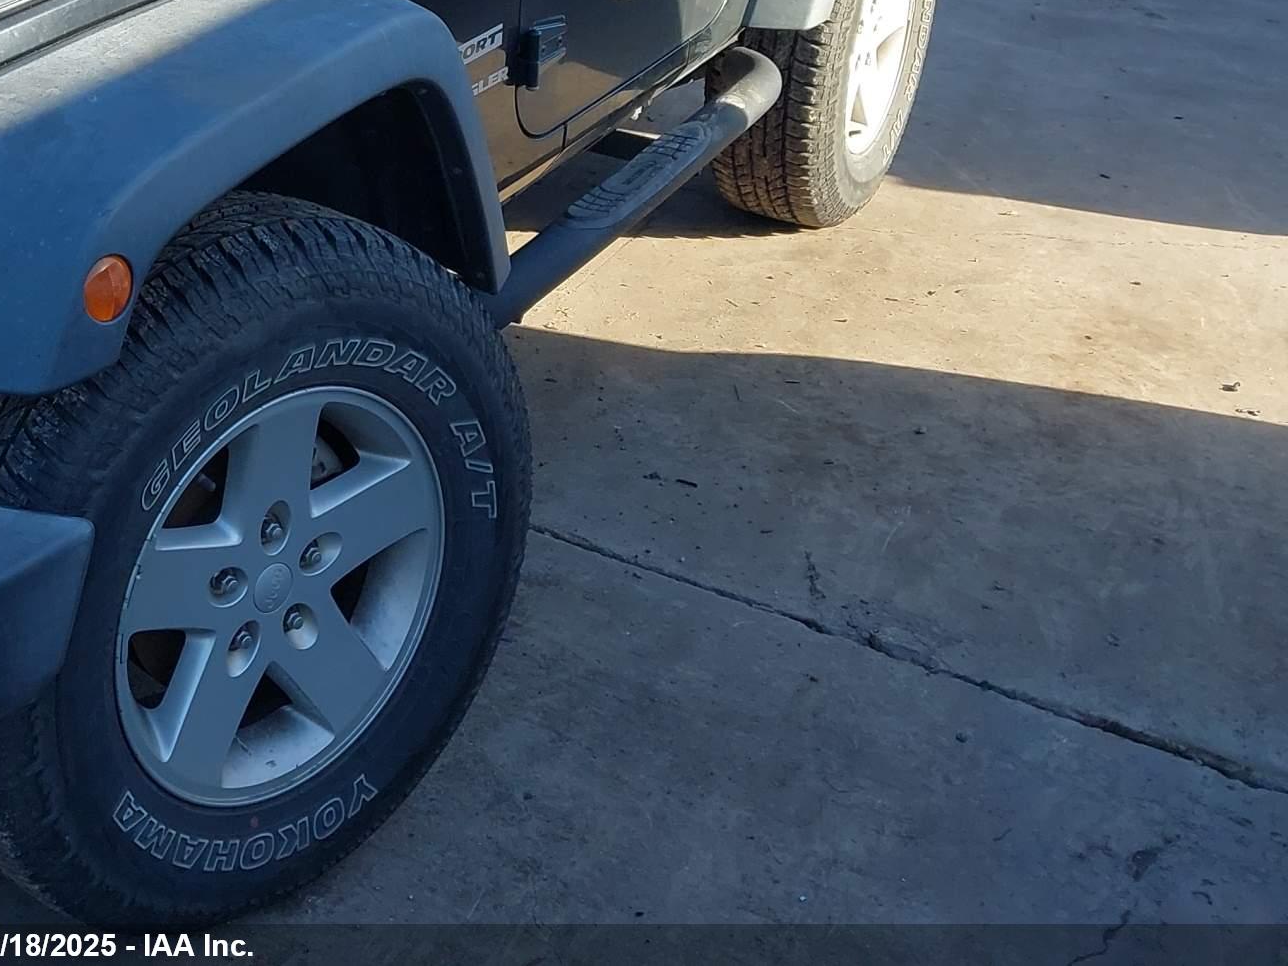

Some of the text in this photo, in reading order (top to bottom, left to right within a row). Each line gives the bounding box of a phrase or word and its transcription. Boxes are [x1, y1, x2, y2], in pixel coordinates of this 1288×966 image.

[141, 338, 498, 520] GEOLANDAR A/T
[112, 774, 379, 872] YOKOHAMA
